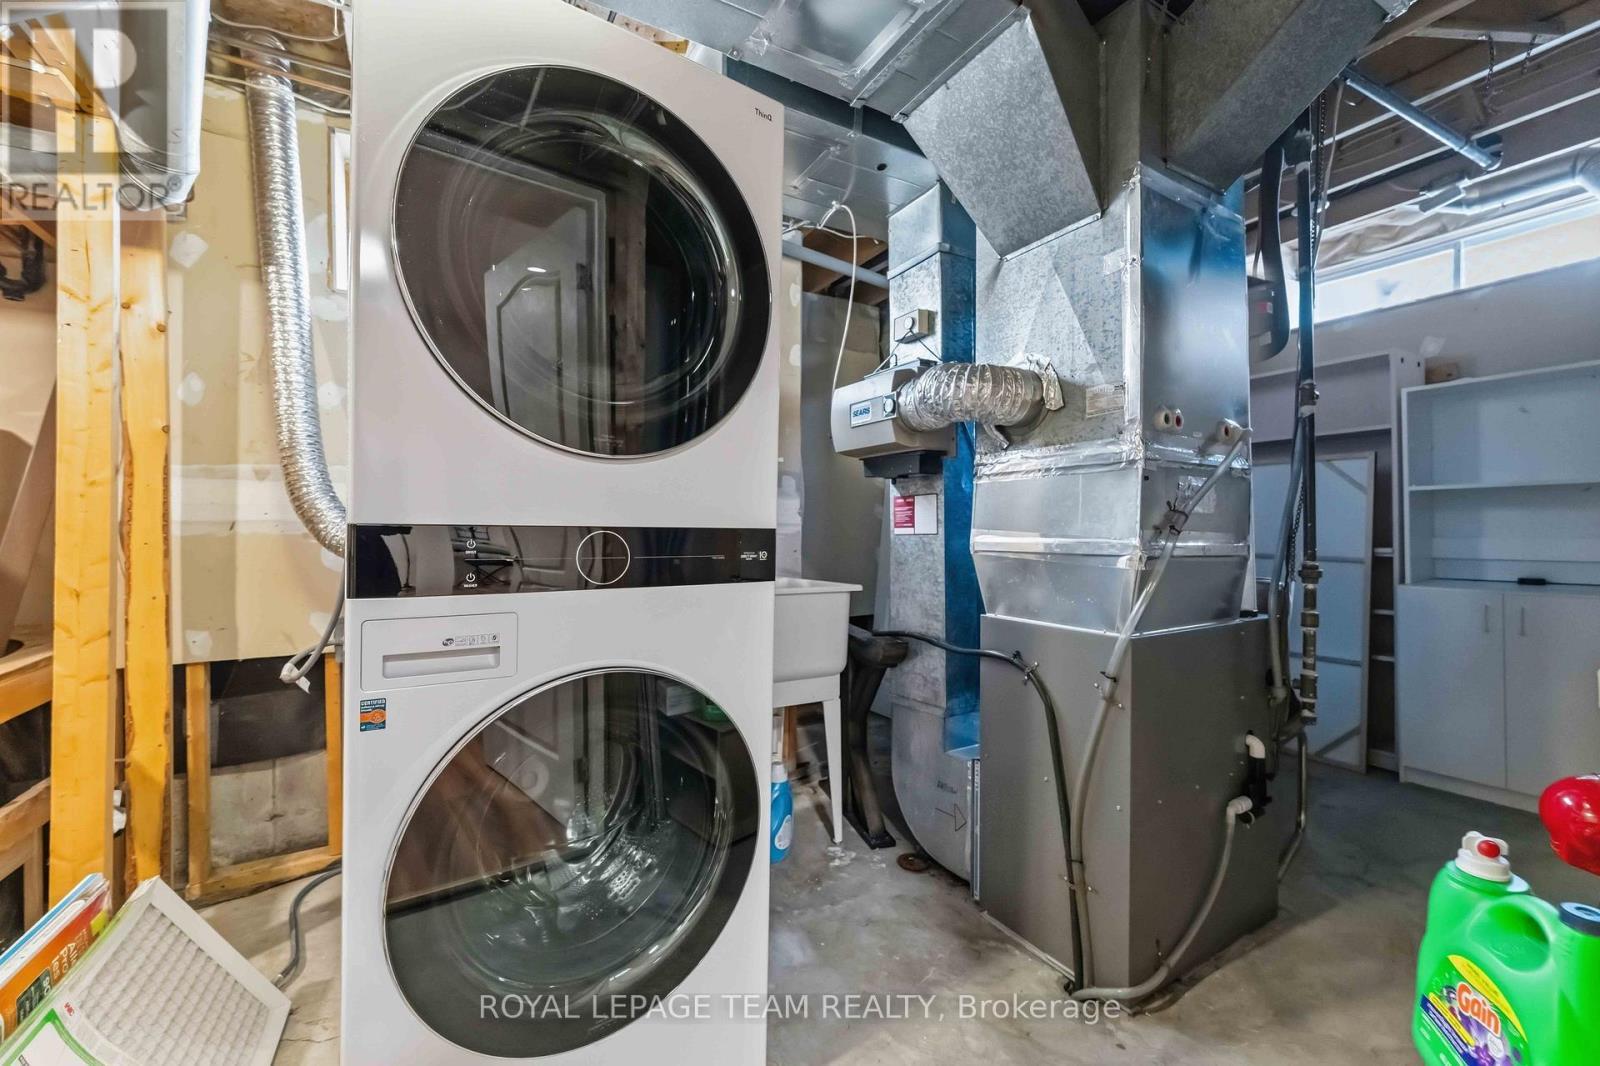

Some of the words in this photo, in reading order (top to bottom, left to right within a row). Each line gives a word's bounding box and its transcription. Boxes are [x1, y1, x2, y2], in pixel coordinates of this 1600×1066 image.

[754, 107, 772, 121] ThinQ
[852, 407, 871, 417] SEARS
[1456, 983, 1500, 1036] Gain
